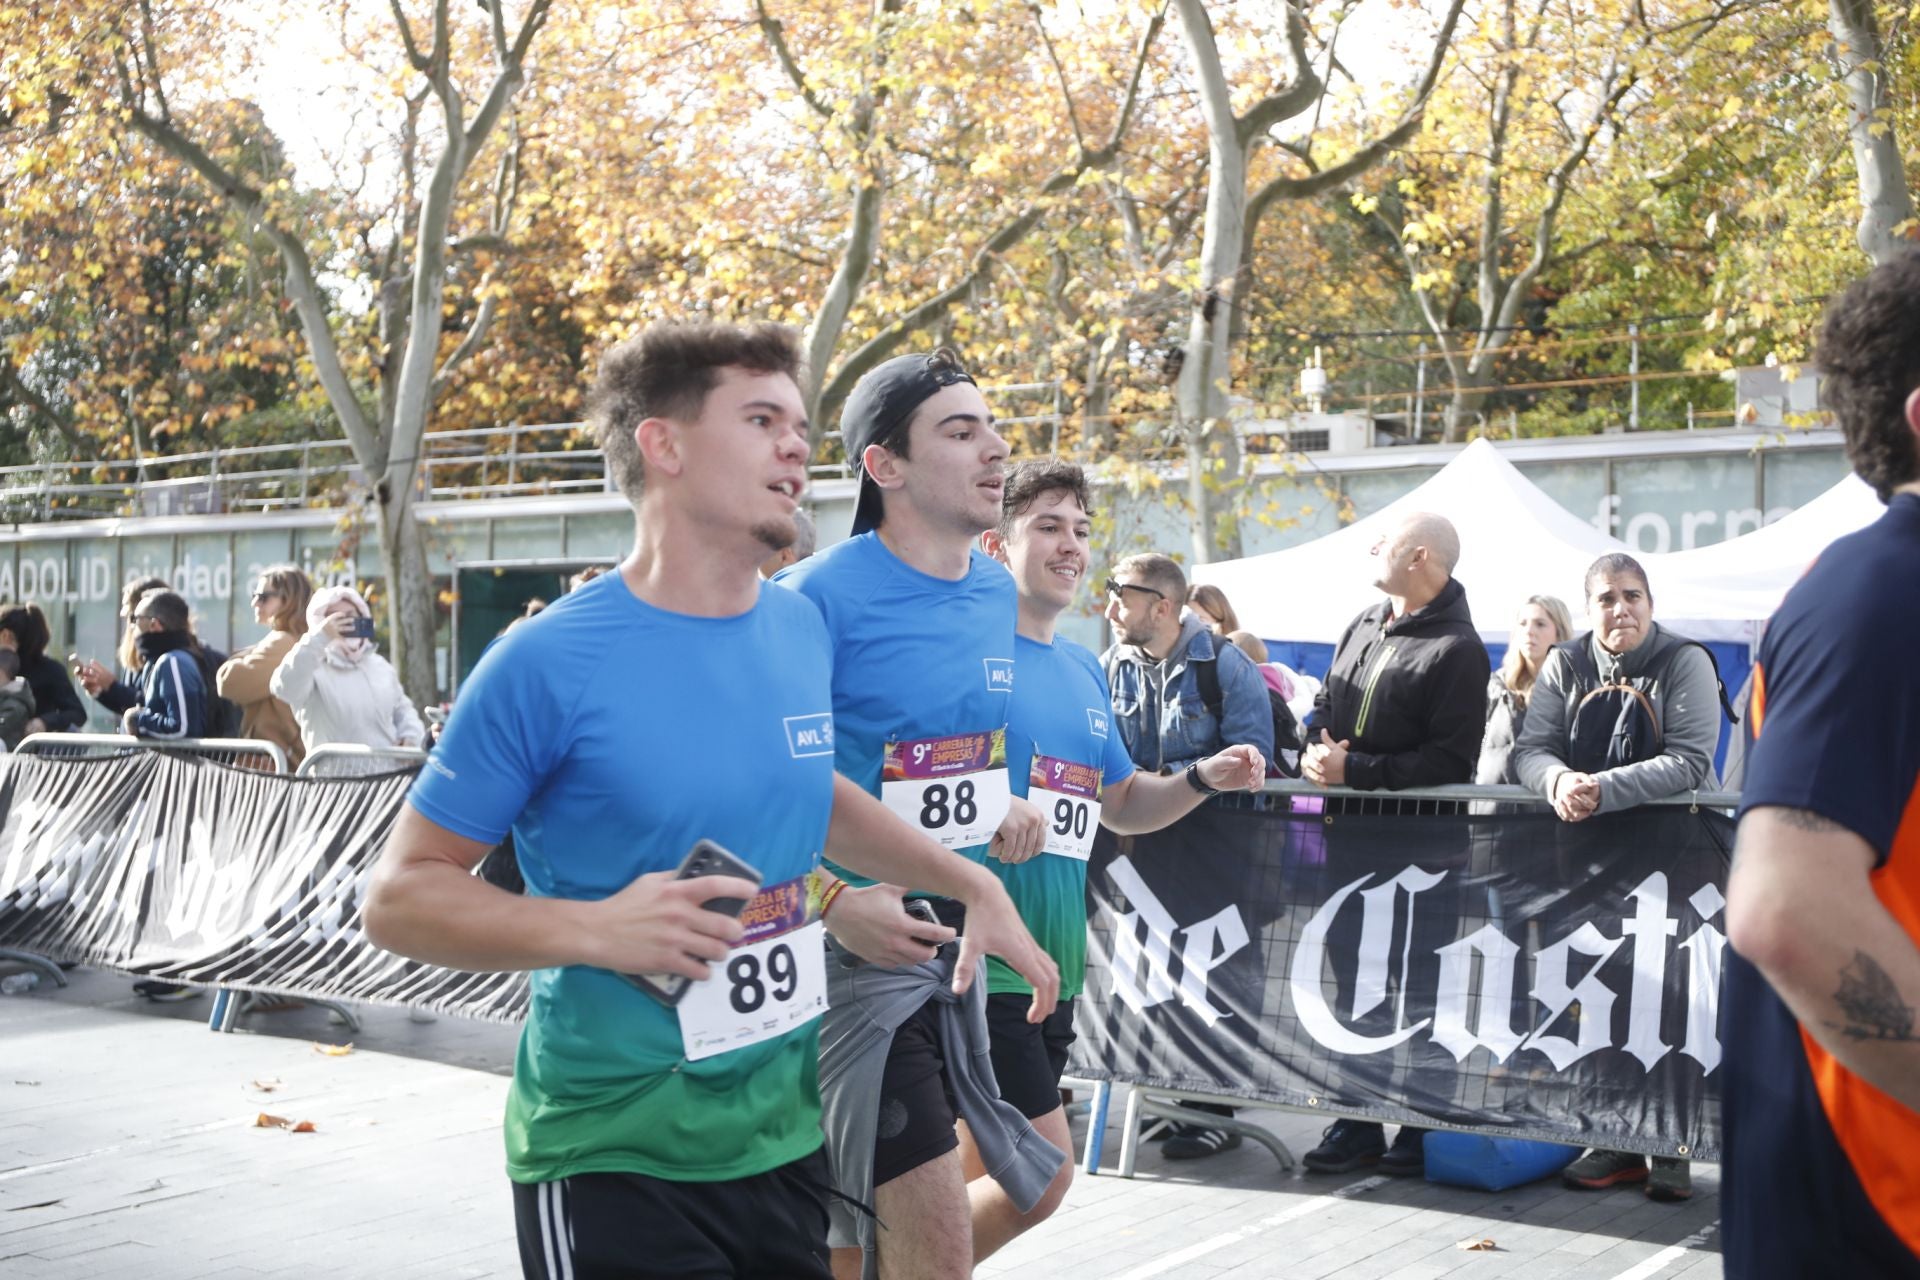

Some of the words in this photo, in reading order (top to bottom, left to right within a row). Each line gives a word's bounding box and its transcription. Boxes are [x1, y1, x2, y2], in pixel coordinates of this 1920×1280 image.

[797, 729, 822, 747] AVL
[931, 747, 973, 765] EMPRESAS
[920, 779, 977, 829] 88
[1052, 798, 1089, 840] 90
[727, 943, 798, 1014] 89
[1105, 853, 1250, 1028] de
[1290, 863, 1727, 1077] Casti
